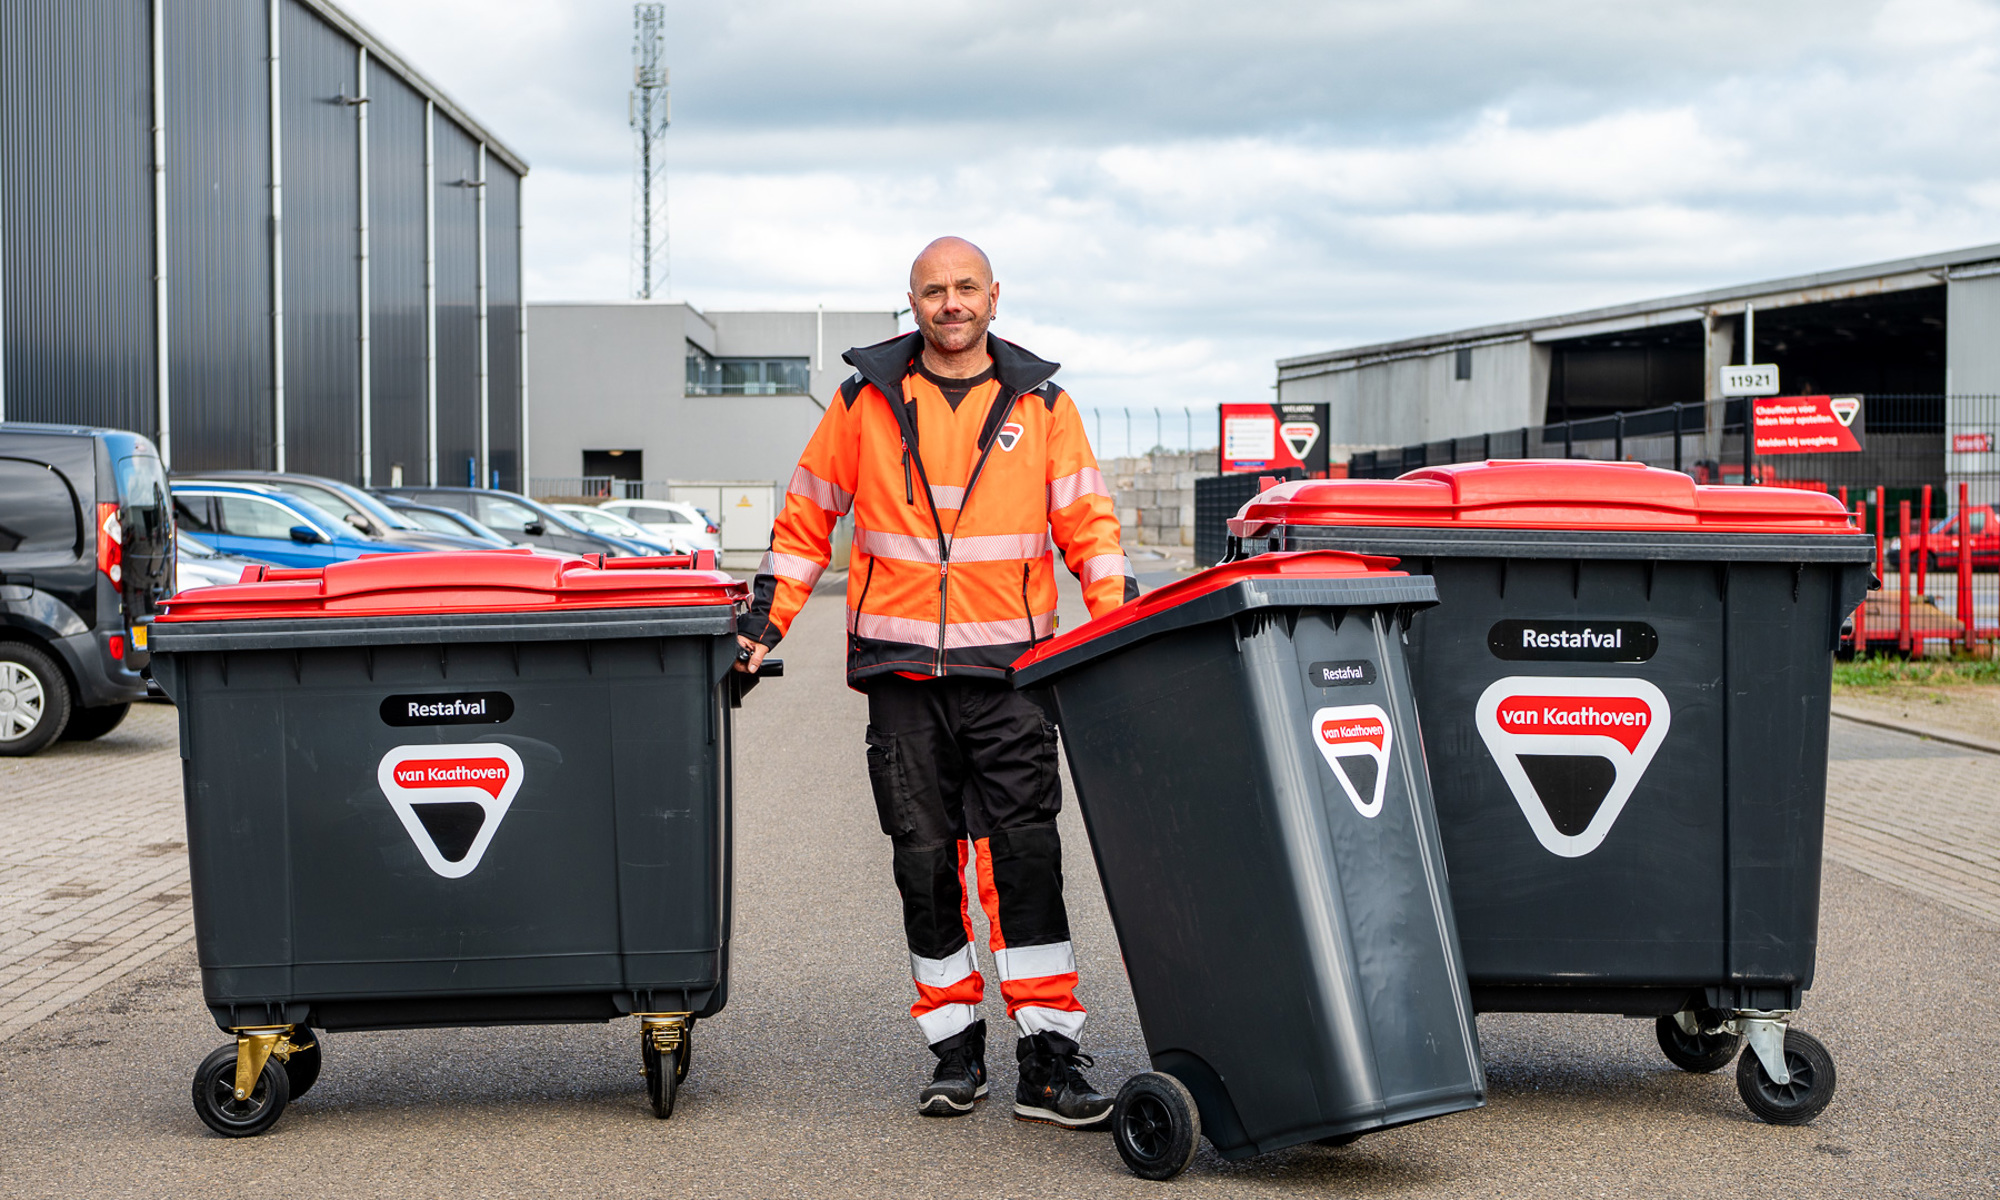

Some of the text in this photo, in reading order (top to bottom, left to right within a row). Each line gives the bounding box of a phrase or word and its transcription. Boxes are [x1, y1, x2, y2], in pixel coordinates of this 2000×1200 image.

[1730, 374, 1770, 387] 11921
[1755, 405, 1817, 416] Chauffeurs voor
[1756, 416, 1779, 426] laden
[1779, 415, 1795, 425] hier
[1757, 437, 1787, 447] Melden
[1787, 436, 1799, 448] bij
[1522, 628, 1622, 648] Restafval
[1322, 665, 1363, 680] Restafval
[408, 699, 486, 717] Restafval
[1502, 706, 1647, 726] van Kaathoven
[1323, 725, 1383, 739] van Kaathoven
[397, 765, 507, 782] van Kaathoven
